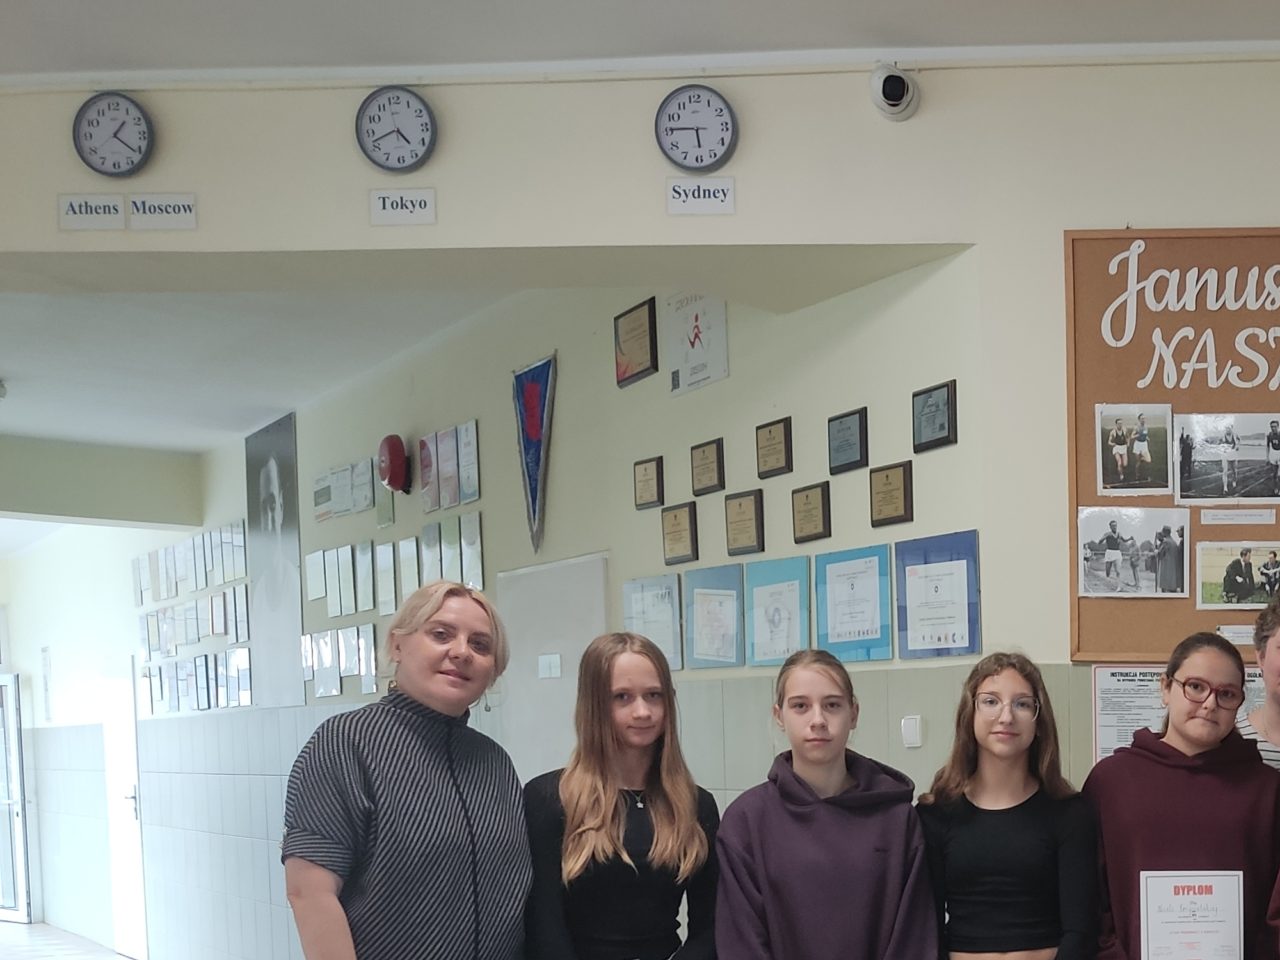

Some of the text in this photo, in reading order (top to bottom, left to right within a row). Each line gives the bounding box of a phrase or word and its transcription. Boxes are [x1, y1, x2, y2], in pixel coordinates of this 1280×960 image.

[388, 96, 400, 105] 12
[688, 94, 701, 104] 12
[107, 102, 120, 111] 12
[378, 103, 386, 112] 11
[678, 102, 686, 110] 11
[97, 108, 105, 117] 11
[415, 108, 424, 118] 2
[668, 112, 680, 122] 10
[715, 108, 724, 117] 2
[88, 119, 100, 128] 10
[133, 117, 142, 126] 2
[368, 114, 381, 124] 10
[420, 122, 429, 132] 3
[721, 122, 729, 132] 3
[84, 132, 92, 140] 9
[138, 131, 146, 140] 3
[366, 128, 375, 138] 9
[418, 137, 425, 147] 4
[670, 141, 679, 151] 8
[718, 137, 725, 146] 4
[89, 146, 98, 155] 8
[373, 142, 381, 152] 8
[383, 152, 390, 162] 7
[410, 149, 418, 159] 5
[681, 151, 688, 160] 7
[695, 154, 704, 163] 6
[709, 149, 717, 159] 5
[100, 157, 106, 166] 7
[126, 157, 134, 166] 5
[397, 156, 405, 164] 6
[112, 161, 121, 170] 6
[672, 185, 729, 203] Sydney
[65, 201, 119, 215] Athens
[131, 200, 194, 215] Moscow
[378, 196, 427, 213] Tokyo
[1173, 884, 1214, 896] DYPLOM
